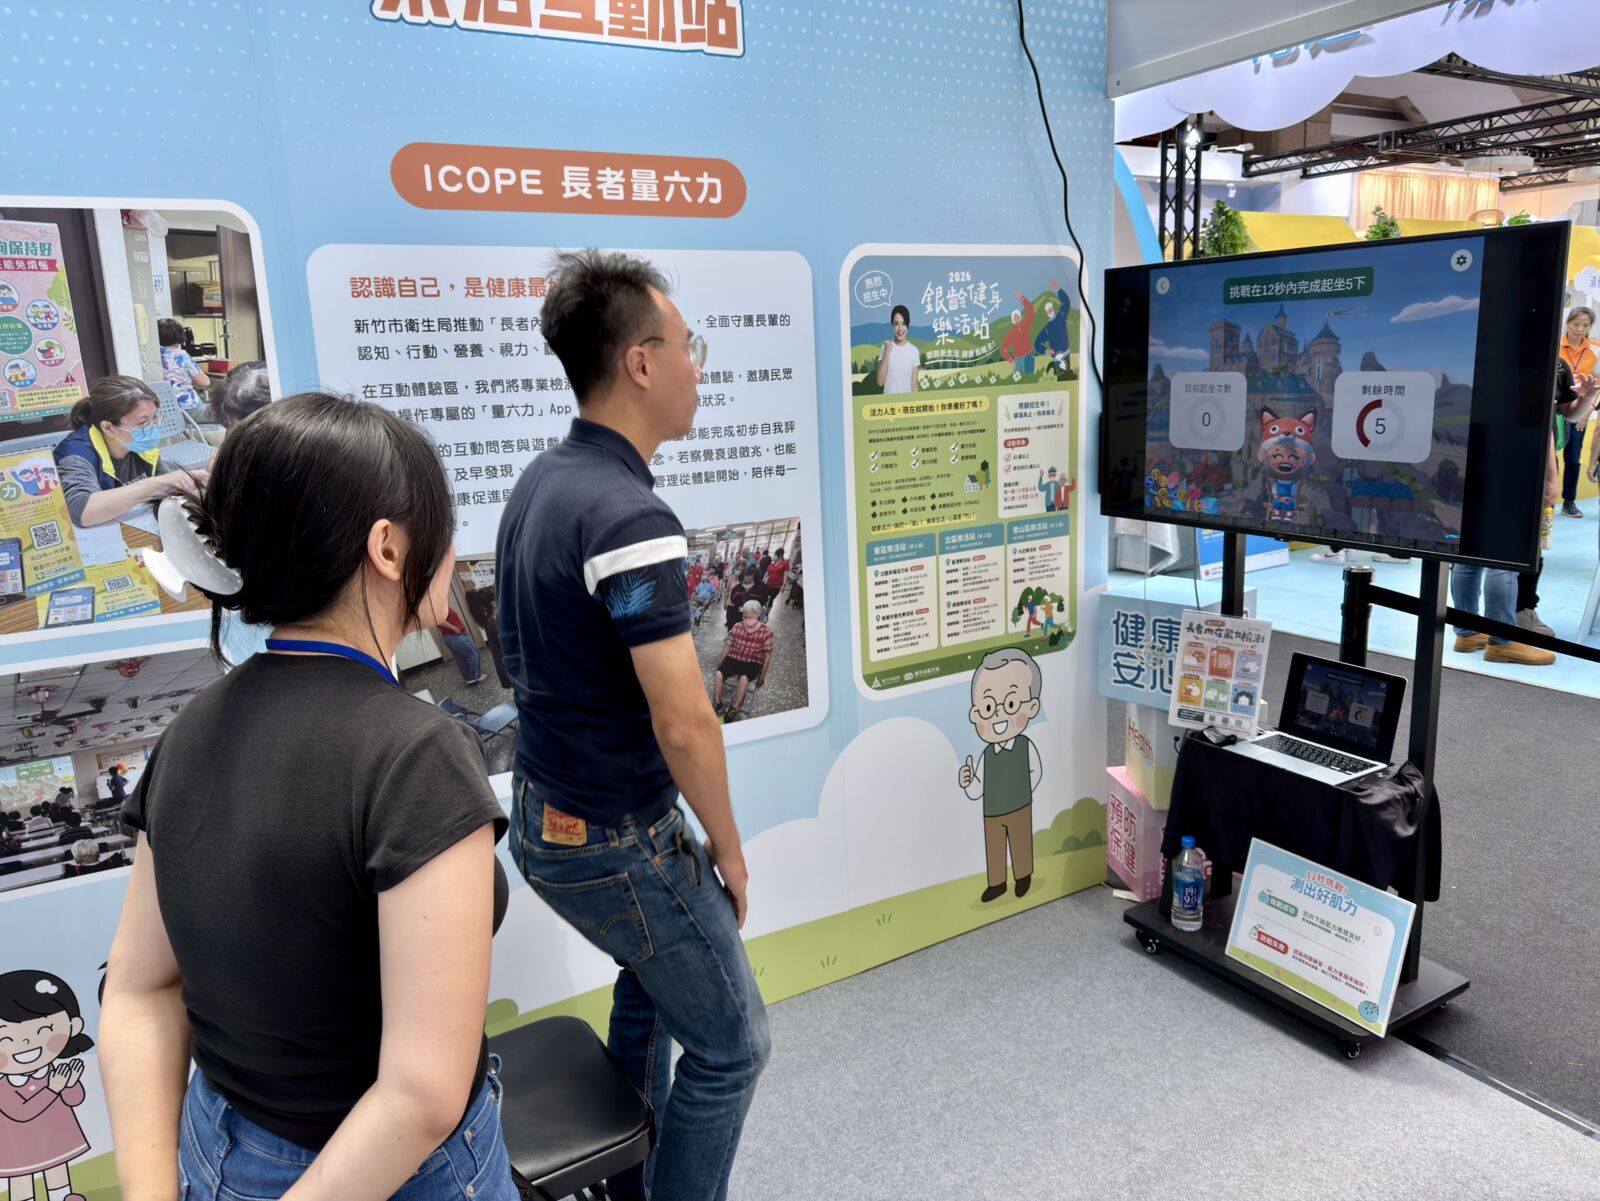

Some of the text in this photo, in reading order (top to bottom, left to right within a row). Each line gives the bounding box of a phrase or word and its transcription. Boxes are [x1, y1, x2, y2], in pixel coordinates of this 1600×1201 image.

[424, 164, 721, 204] ICOPE 長者量六力
[0, 259, 48, 271] 能免煩惱
[948, 271, 972, 283] 2026
[1229, 276, 1366, 298] 挑戰在12秒內完成起坐5下
[863, 288, 888, 303] 招生中
[921, 280, 1003, 315] 銀齡健身
[932, 313, 990, 346] 樂活站
[1185, 384, 1405, 396] 目前起坐次數 剩餘時間
[1202, 412, 1386, 434] 0 5
[438, 436, 566, 457] 的互動問答與遊戲
[450, 489, 513, 507] 康促進與
[1112, 610, 1181, 654] 健康
[1290, 876, 1358, 917] 測出好肌力
